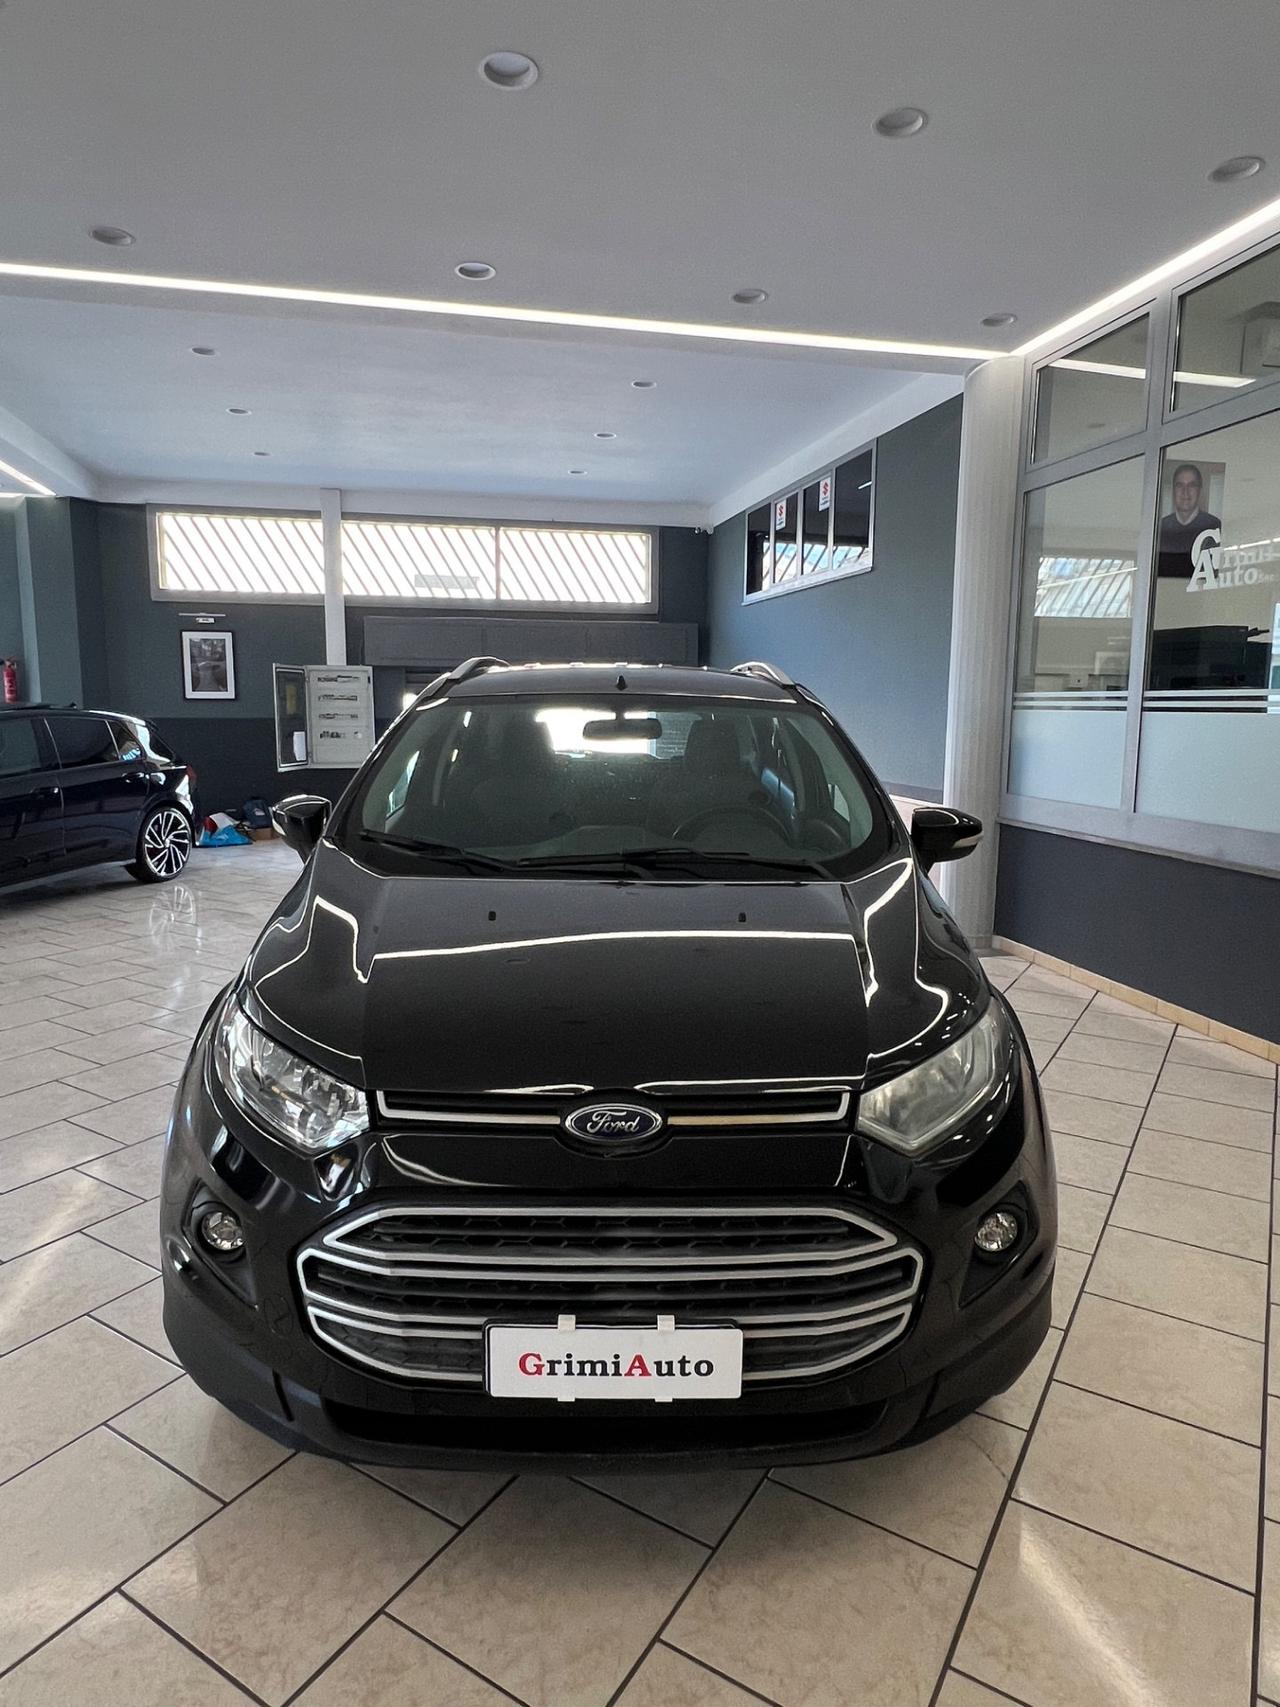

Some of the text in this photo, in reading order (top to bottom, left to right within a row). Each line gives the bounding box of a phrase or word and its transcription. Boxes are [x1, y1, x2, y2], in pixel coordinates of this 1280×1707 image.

[1186, 549, 1258, 593] Auto
[586, 1110, 641, 1134] Ford
[518, 1352, 715, 1377] GrimiAuto
